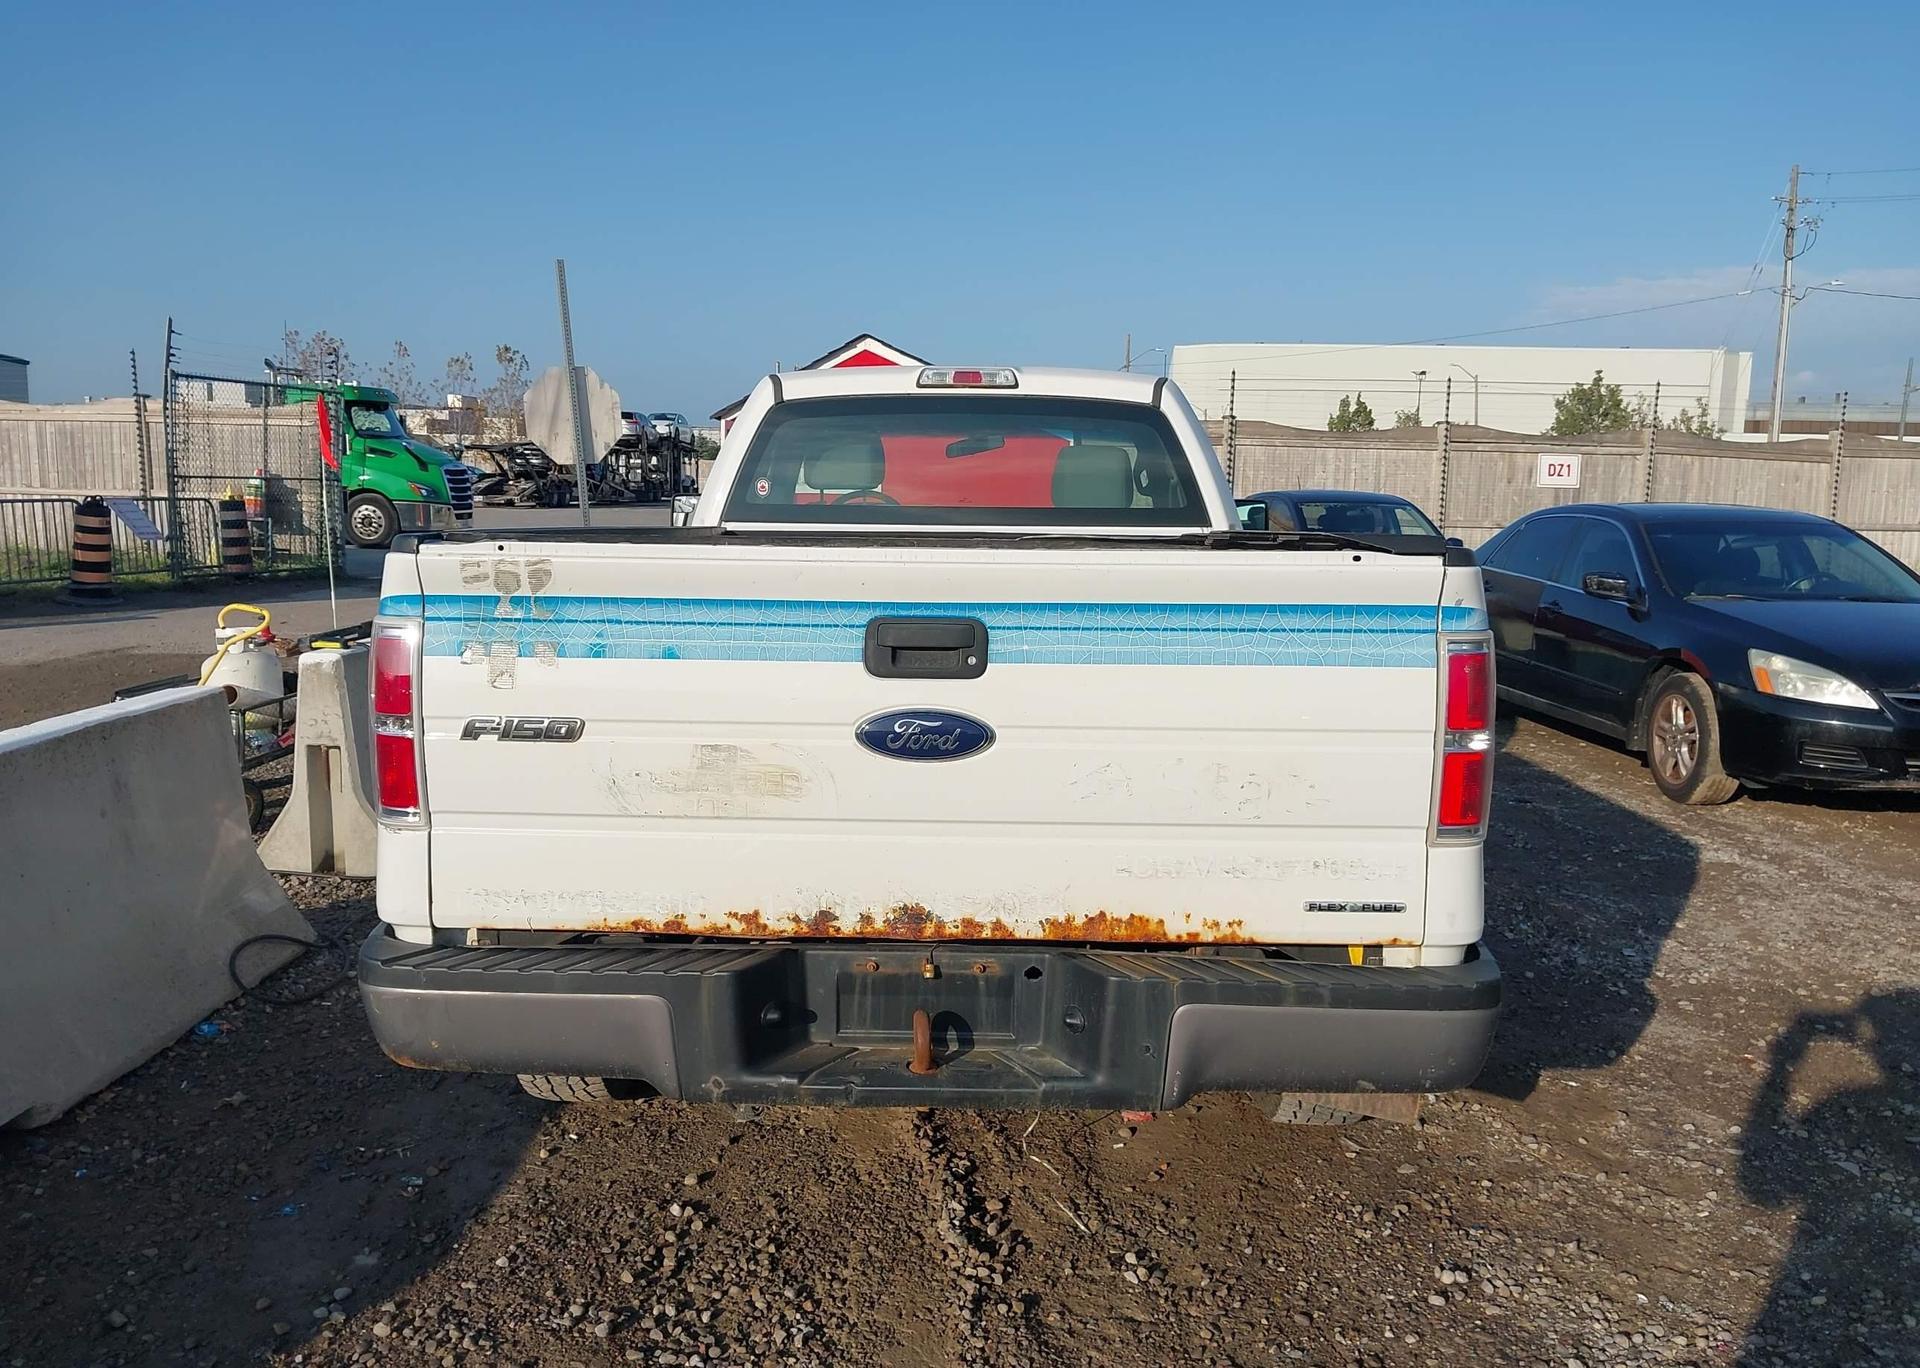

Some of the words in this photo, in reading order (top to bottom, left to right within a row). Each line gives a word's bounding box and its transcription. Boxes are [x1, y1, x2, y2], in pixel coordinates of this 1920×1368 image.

[1548, 463, 1571, 477] DZ1
[460, 716, 585, 743] F-150
[887, 718, 961, 751] Ford
[1308, 903, 1348, 912] FLEX
[1361, 903, 1404, 912] FUEL
